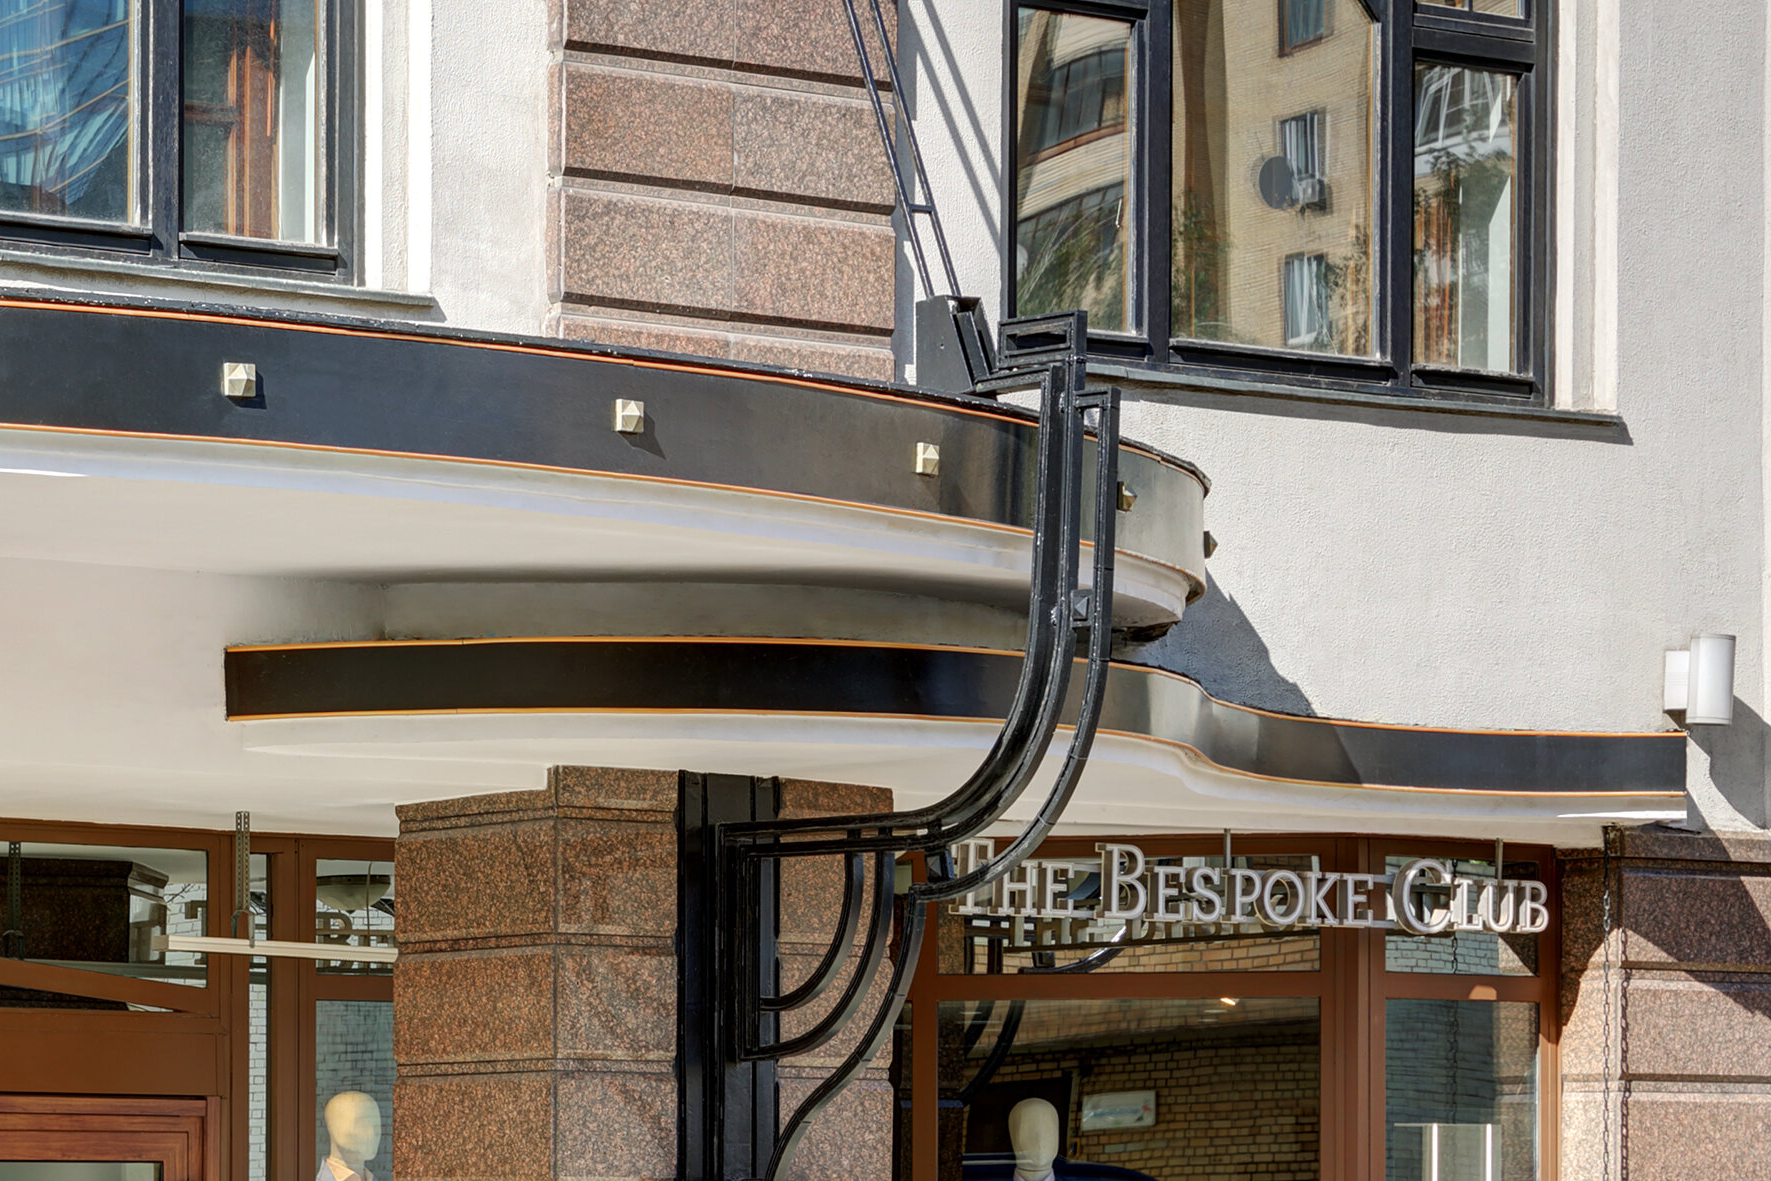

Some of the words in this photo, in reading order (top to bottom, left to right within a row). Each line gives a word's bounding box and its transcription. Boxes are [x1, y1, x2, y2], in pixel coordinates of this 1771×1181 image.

[949, 838, 1076, 917] THE
[1094, 842, 1374, 928] BESPOKE
[1392, 858, 1550, 935] CLUB
